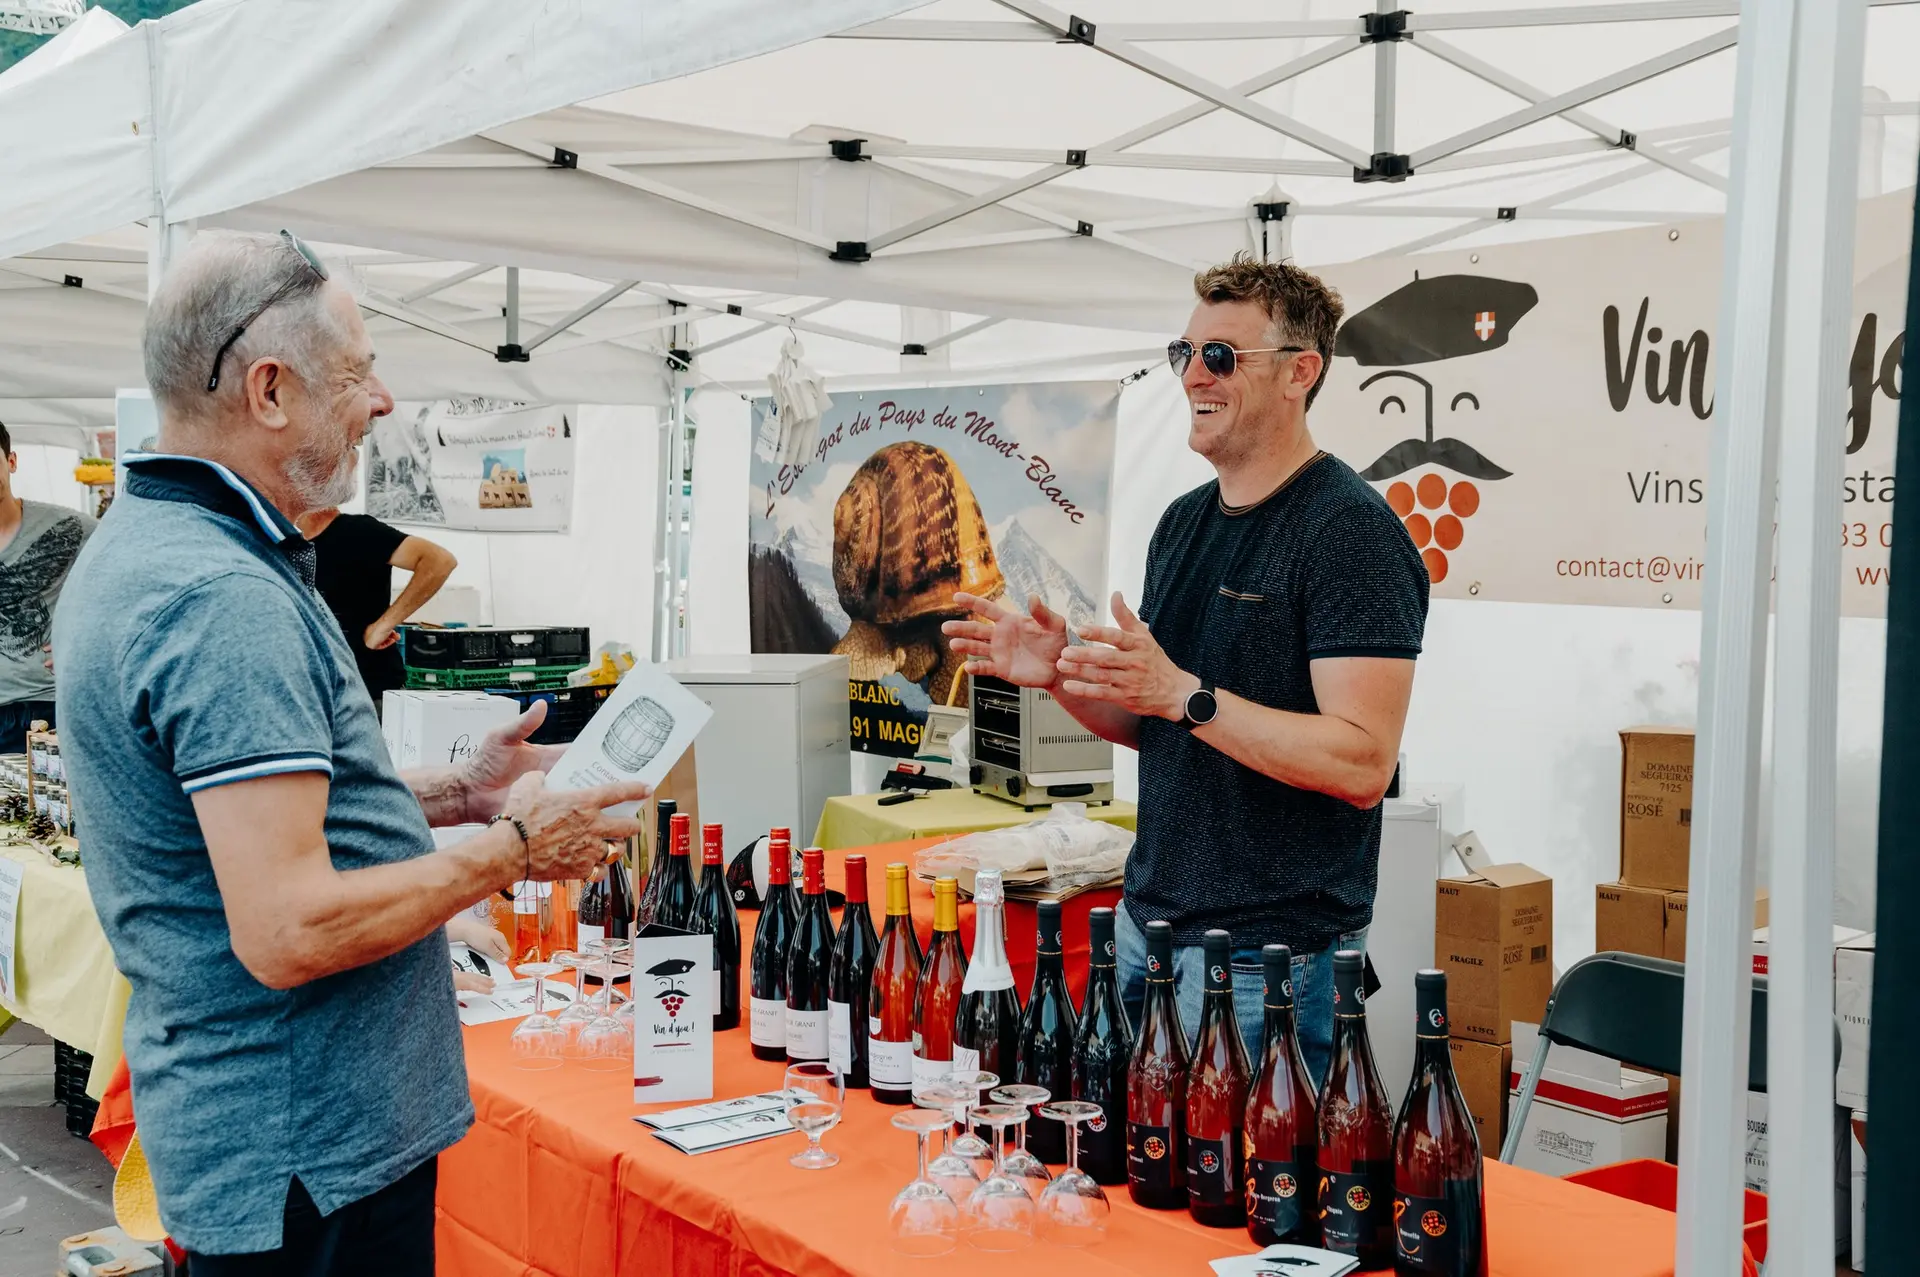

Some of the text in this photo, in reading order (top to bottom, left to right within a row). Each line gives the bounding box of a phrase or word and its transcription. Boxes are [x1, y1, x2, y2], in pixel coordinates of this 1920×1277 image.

[1603, 296, 1714, 420] Vin
[849, 411, 871, 437] du
[878, 401, 927, 433] Pays
[933, 405, 957, 430] du
[1627, 470, 1704, 504] Vins
[849, 682, 900, 706] BLANC
[1647, 763, 1693, 774] DOMAINE
[1660, 783, 1682, 793] 7125
[1627, 801, 1664, 817] ROSÉ
[1439, 887, 1460, 896] HAUT
[1599, 892, 1620, 901] HAUT
[1450, 954, 1484, 966] FRAGILE
[653, 1023, 667, 1035] Vin
[1450, 1043, 1463, 1052] AUT
